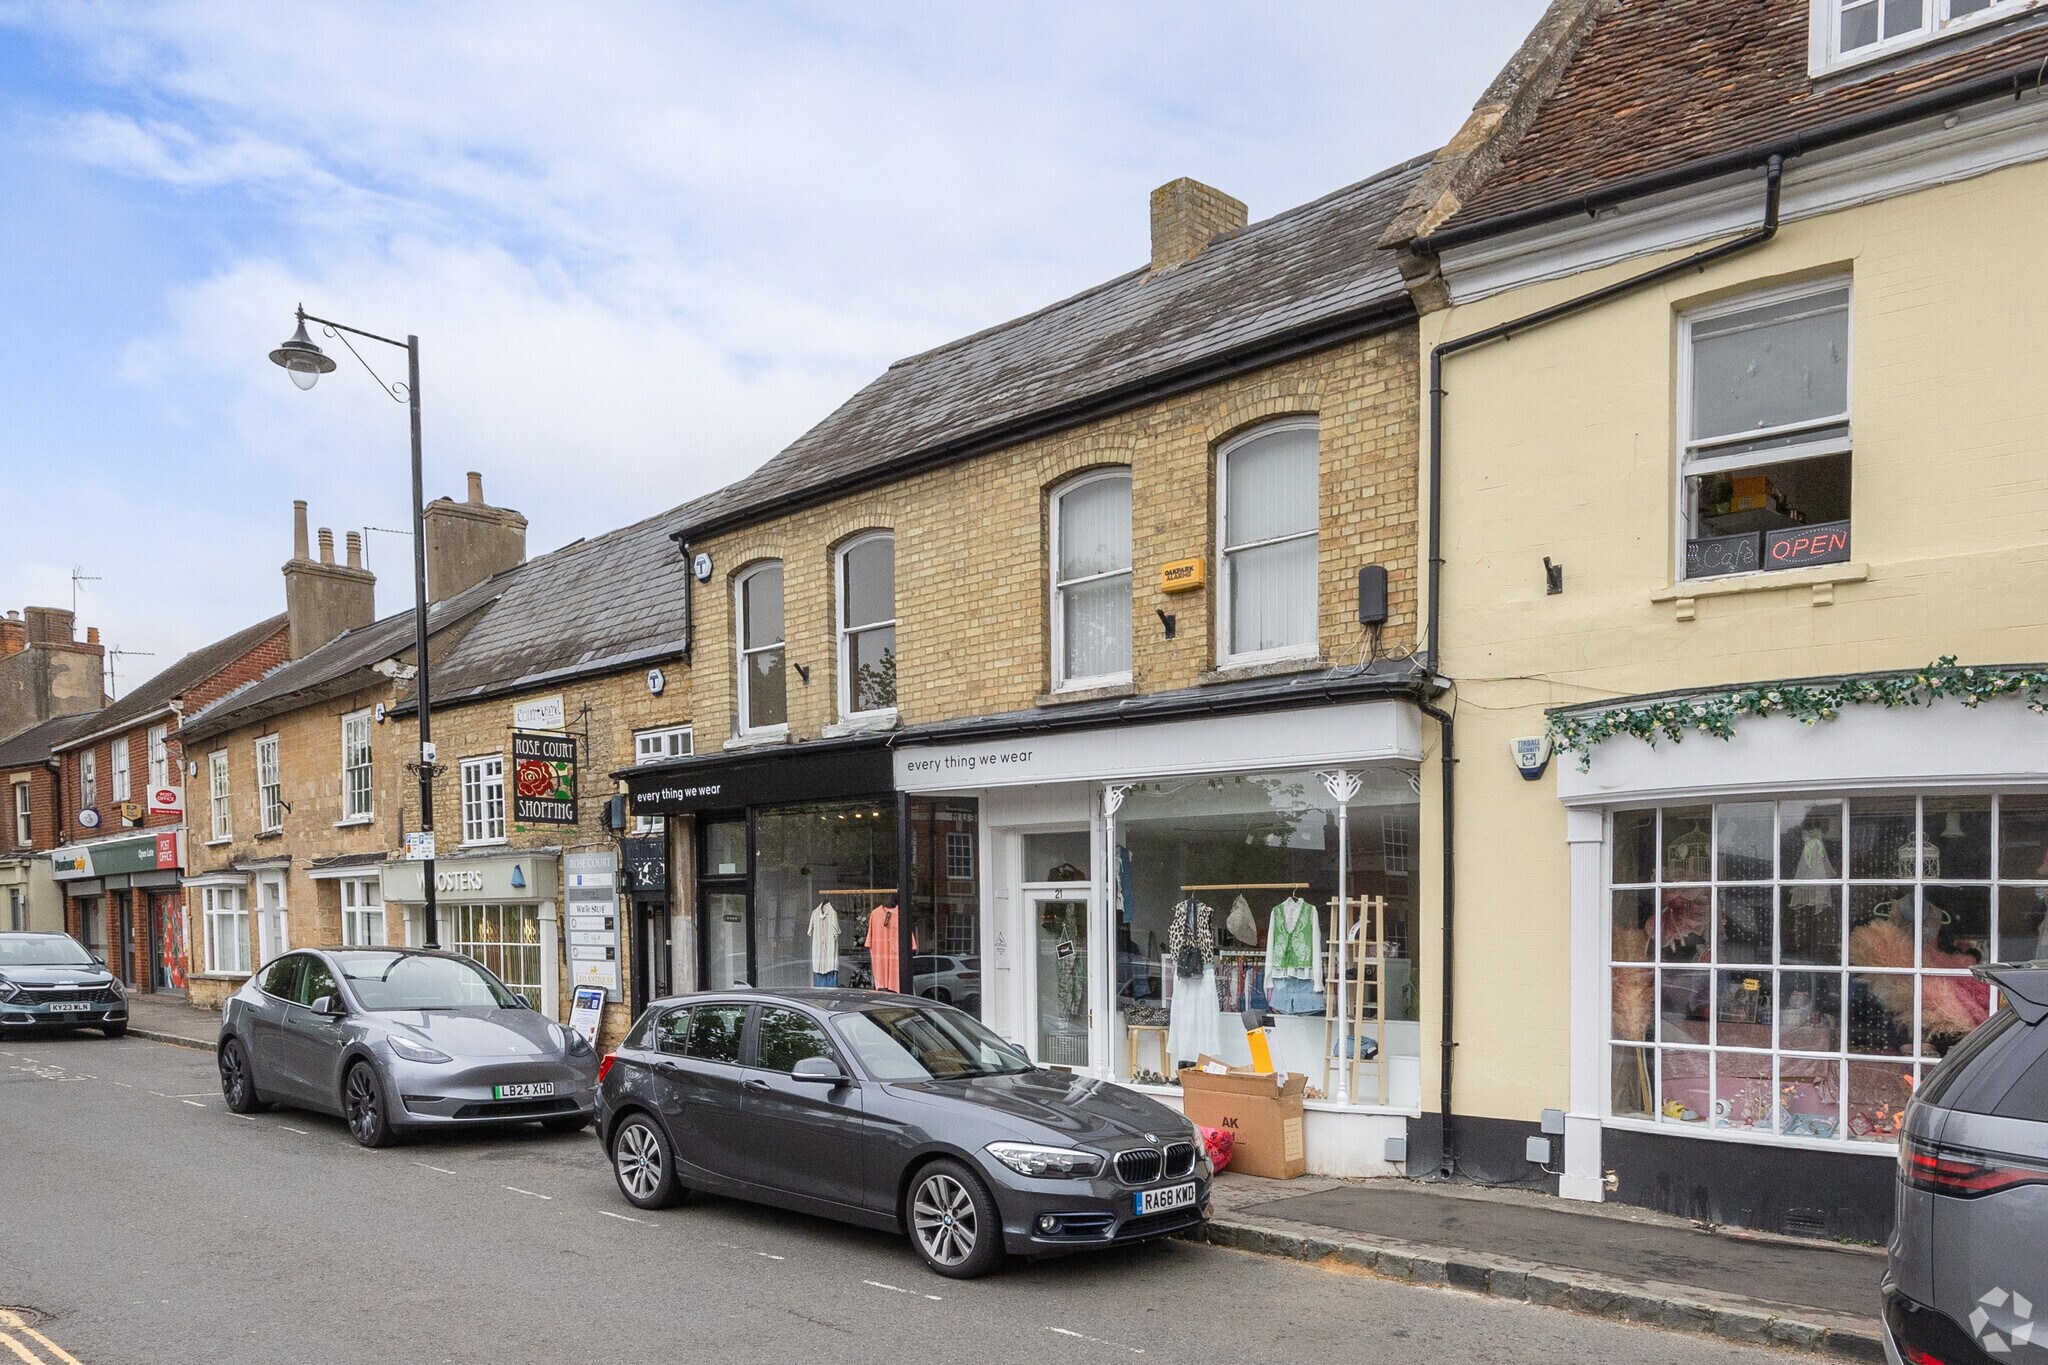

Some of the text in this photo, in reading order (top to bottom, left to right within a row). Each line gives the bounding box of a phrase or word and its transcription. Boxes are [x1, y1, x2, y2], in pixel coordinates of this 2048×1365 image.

[1772, 532, 1847, 560] OPEN
[1164, 566, 1194, 576] OAKPARK
[1166, 572, 1191, 581] ALARMS
[515, 739, 573, 758] ROSE COURT
[1517, 739, 1540, 747] TINDALL
[907, 751, 1033, 773] every thing we wear
[637, 785, 721, 803] every thing we wear
[518, 800, 573, 820] SHOPPING
[160, 839, 170, 851] POST
[138, 849, 147, 860] Open
[159, 850, 172, 862] OFFICE
[570, 857, 611, 869] ROSE COURT
[416, 870, 483, 892] WOSTERS
[1055, 889, 1062, 899] 21
[575, 974, 614, 986] LEO ANTIQUES
[501, 1083, 553, 1097] LB24 XHD
[1221, 1116, 1239, 1129] AK
[1145, 1186, 1194, 1209] RA68 KWD
